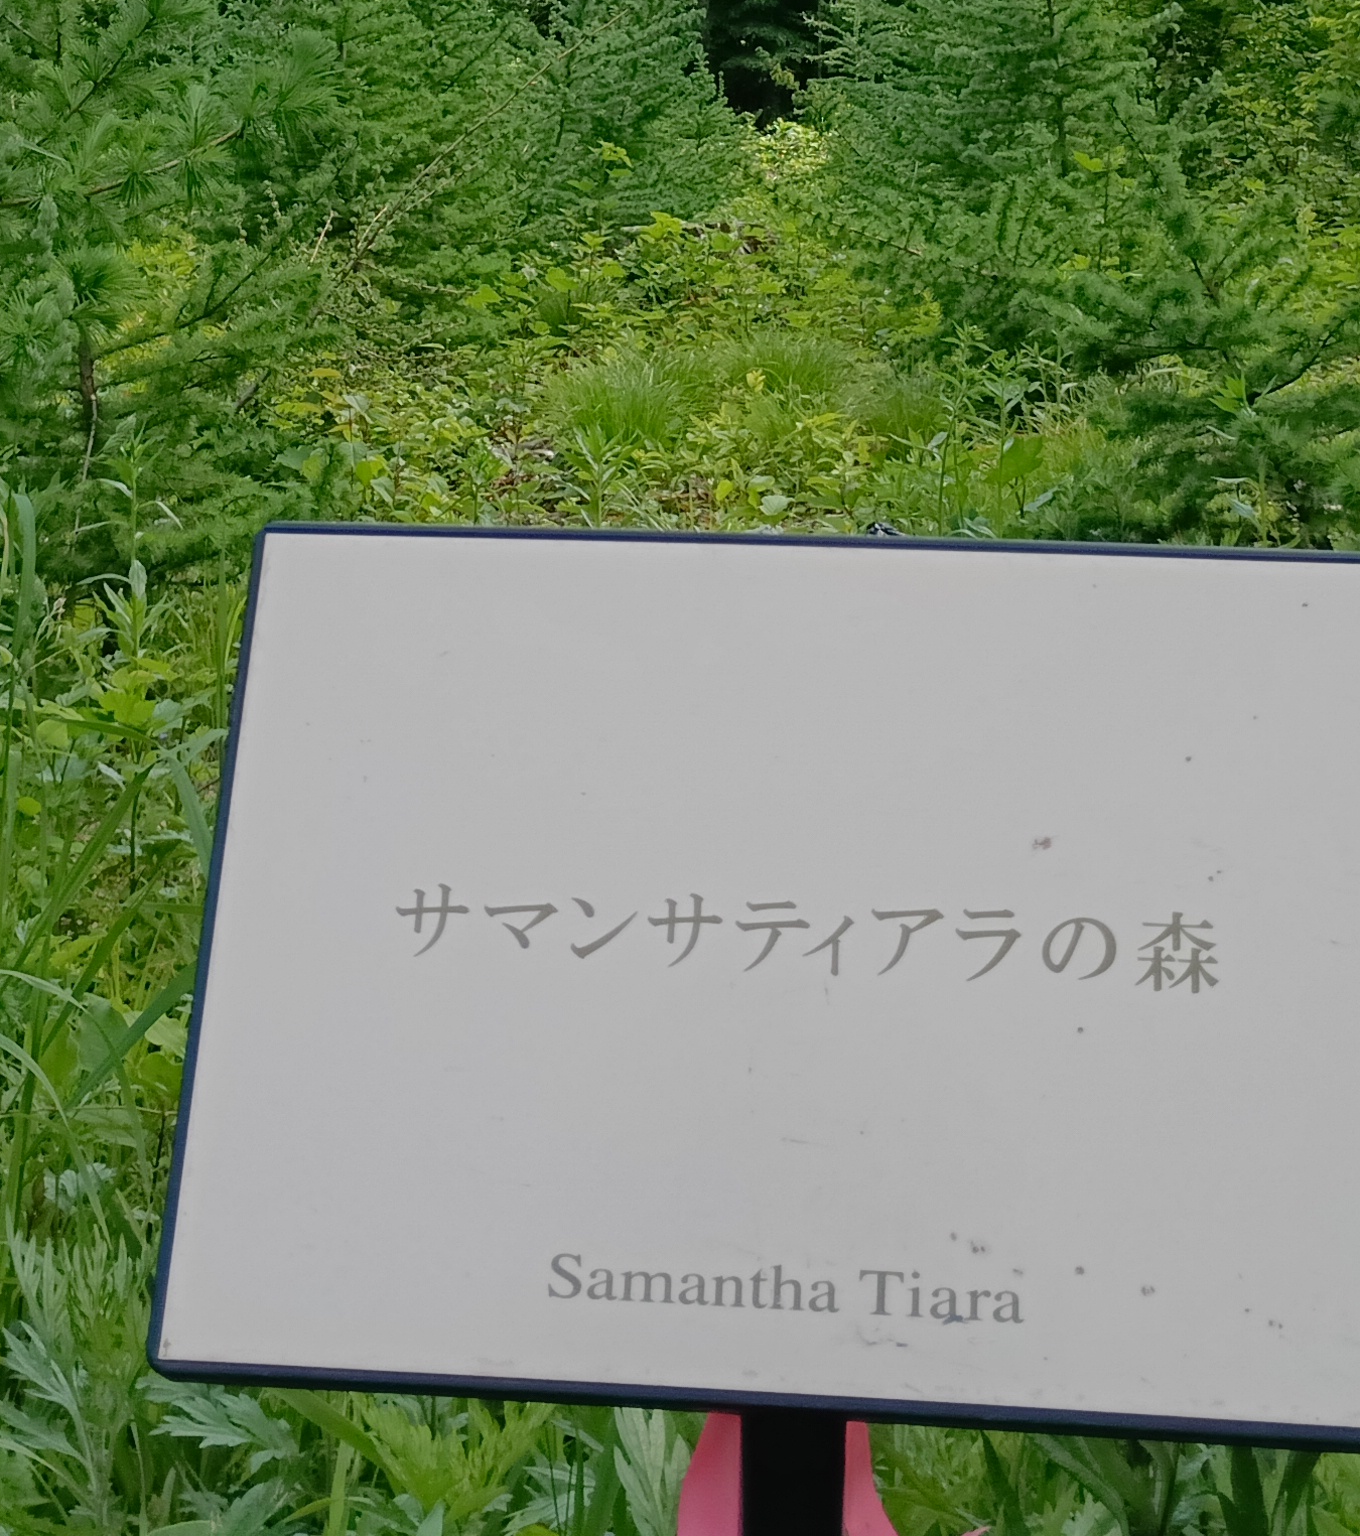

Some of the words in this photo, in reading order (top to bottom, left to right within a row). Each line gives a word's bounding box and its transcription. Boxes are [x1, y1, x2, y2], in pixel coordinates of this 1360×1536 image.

[395, 882, 1220, 995] サマンサティアラの森
[547, 1252, 841, 1314] Samantha
[858, 1268, 1025, 1325] Tiara
